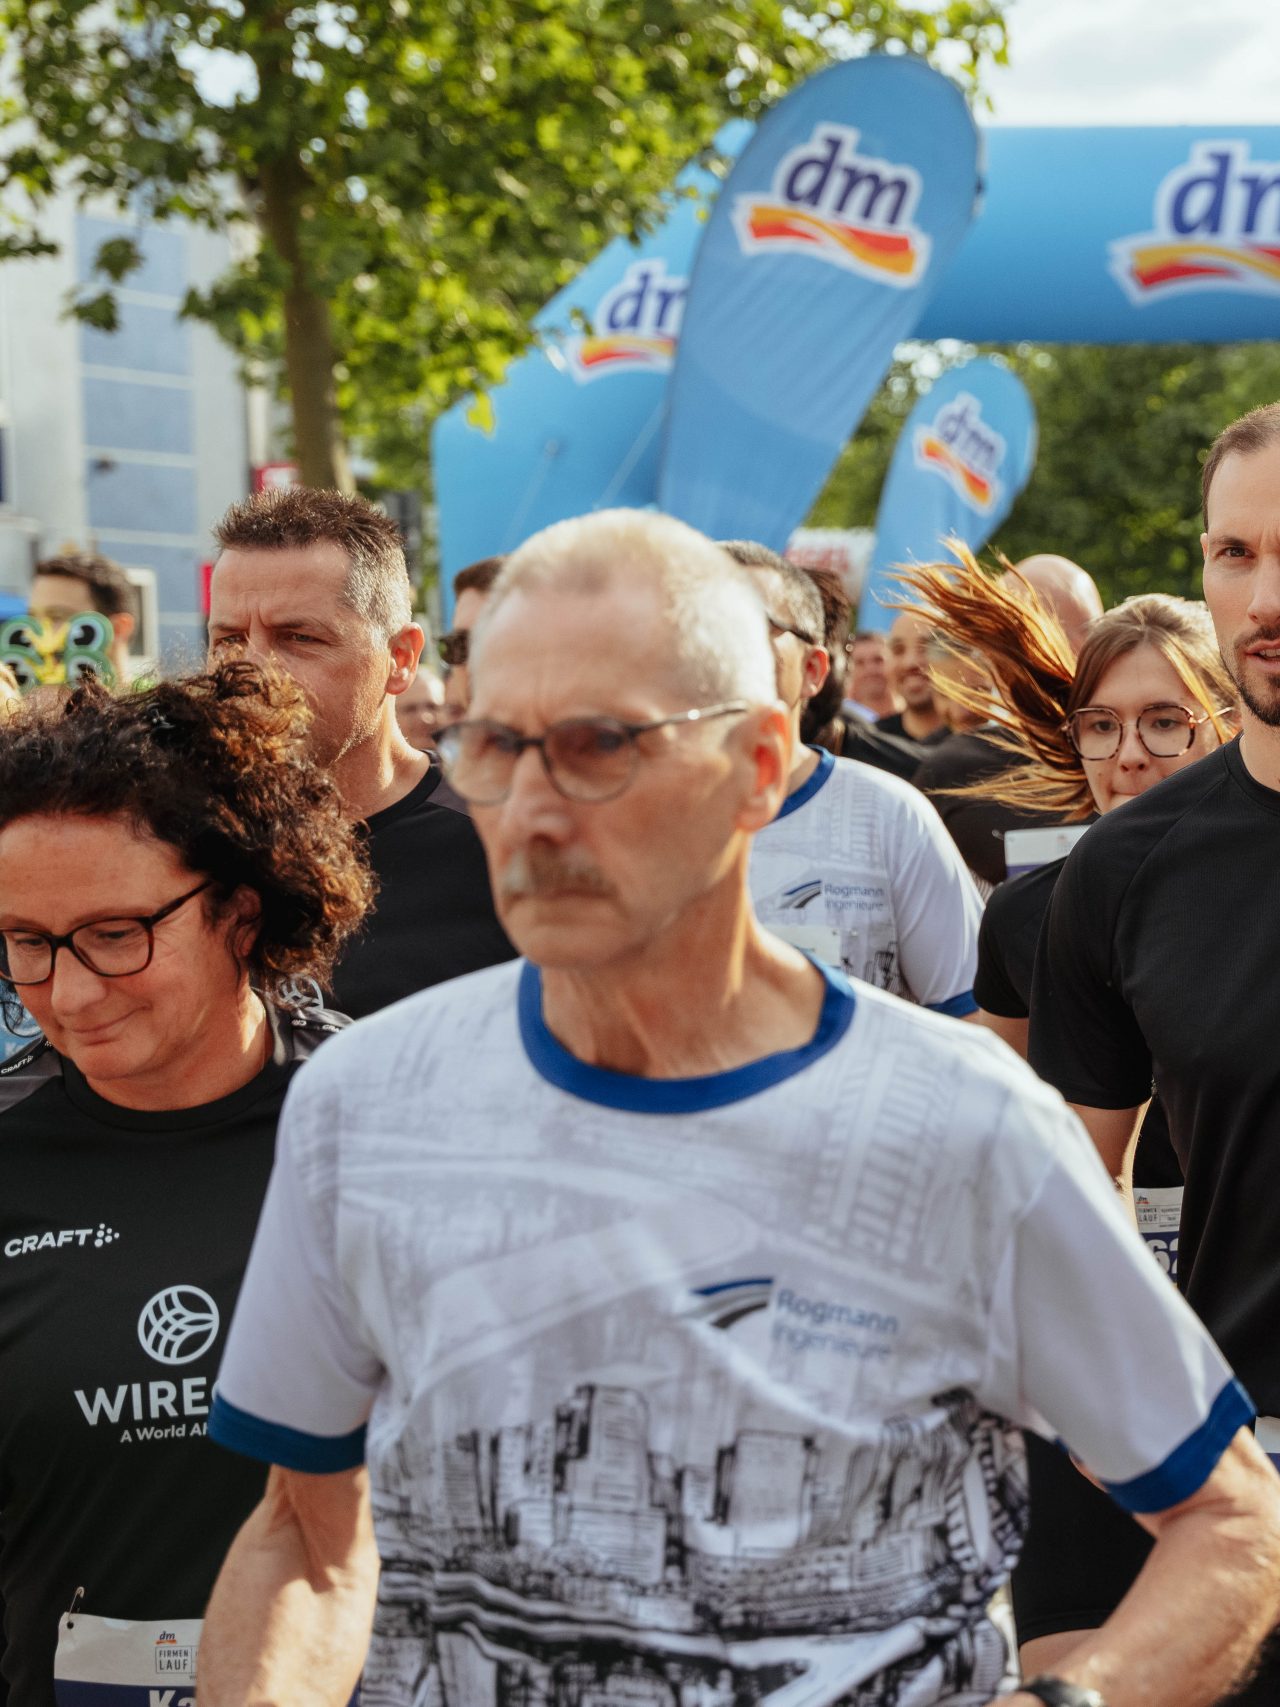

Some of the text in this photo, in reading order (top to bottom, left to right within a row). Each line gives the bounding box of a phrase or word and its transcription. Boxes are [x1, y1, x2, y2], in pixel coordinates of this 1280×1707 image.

[786, 138, 908, 225] dm
[824, 885, 884, 897] Rogmann
[1, 1058, 28, 1074] CRAFT
[4, 1228, 93, 1257] CRAFT
[777, 1289, 899, 1333] Rogmann
[74, 1376, 216, 1426] WIRE
[120, 1430, 132, 1443] A
[136, 1424, 186, 1440] World
[159, 1631, 175, 1641] dm
[158, 1649, 189, 1658] FIRMEN
[159, 1659, 188, 1671] LAUF
